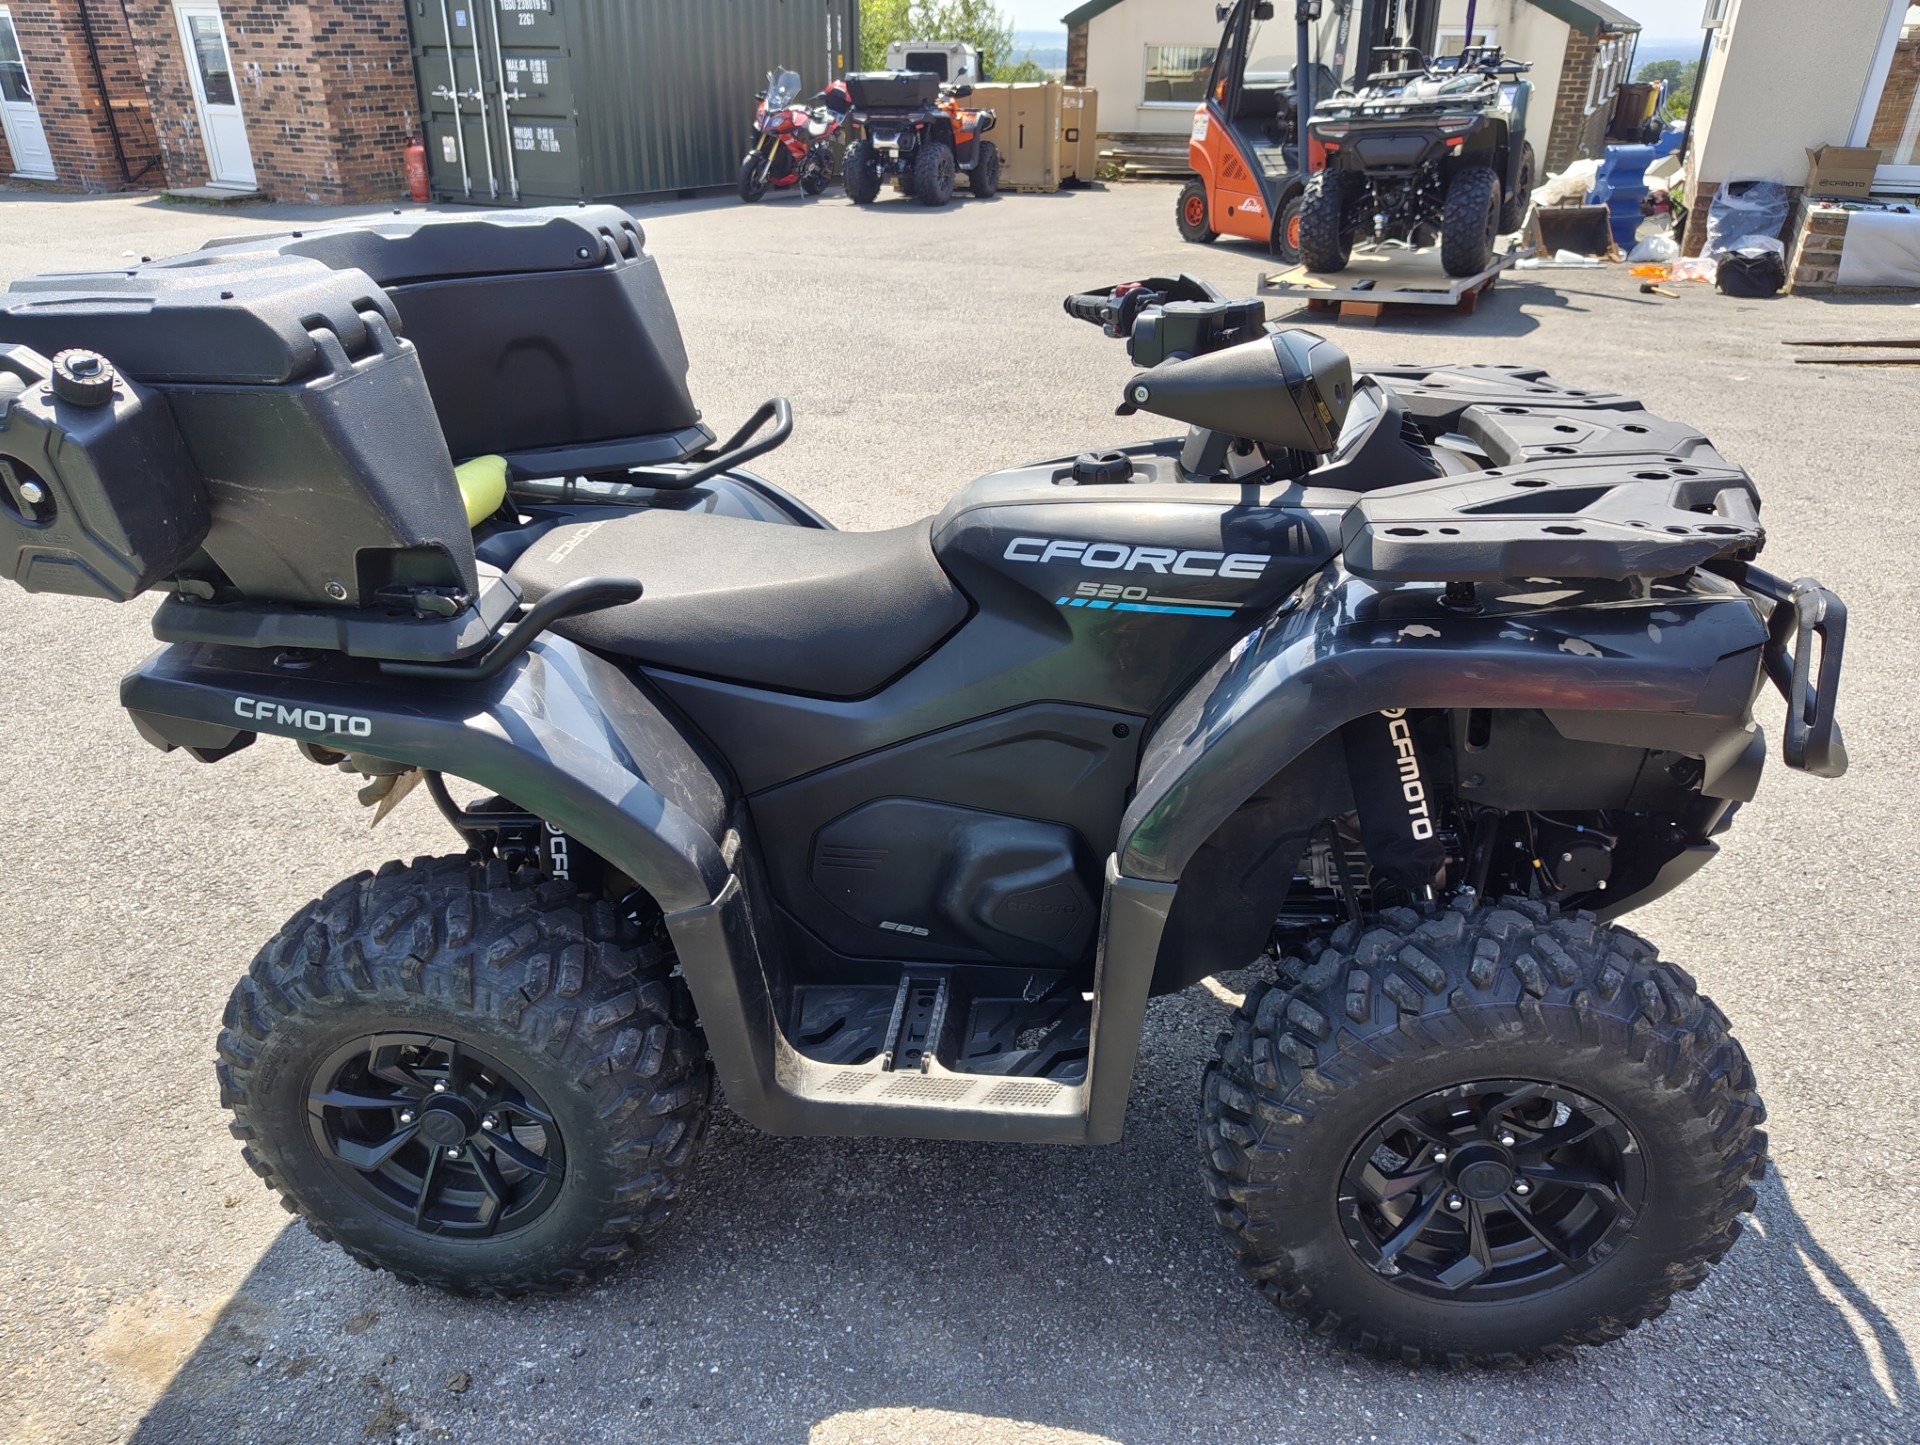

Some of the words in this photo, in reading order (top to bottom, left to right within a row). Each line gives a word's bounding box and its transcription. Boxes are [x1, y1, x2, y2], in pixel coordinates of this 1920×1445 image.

[518, 13, 535, 25] 22G1
[1829, 180, 1866, 188] CFMOTO
[1237, 196, 1262, 213] Linde
[16, 529, 72, 544] DANGER
[1003, 537, 1271, 579] CFORCE
[1075, 582, 1148, 600] 520
[234, 696, 372, 737] CFMOTO
[1388, 719, 1433, 840] CFMOTO
[1006, 901, 1076, 914] CFMOTO
[879, 920, 931, 936] EBS
